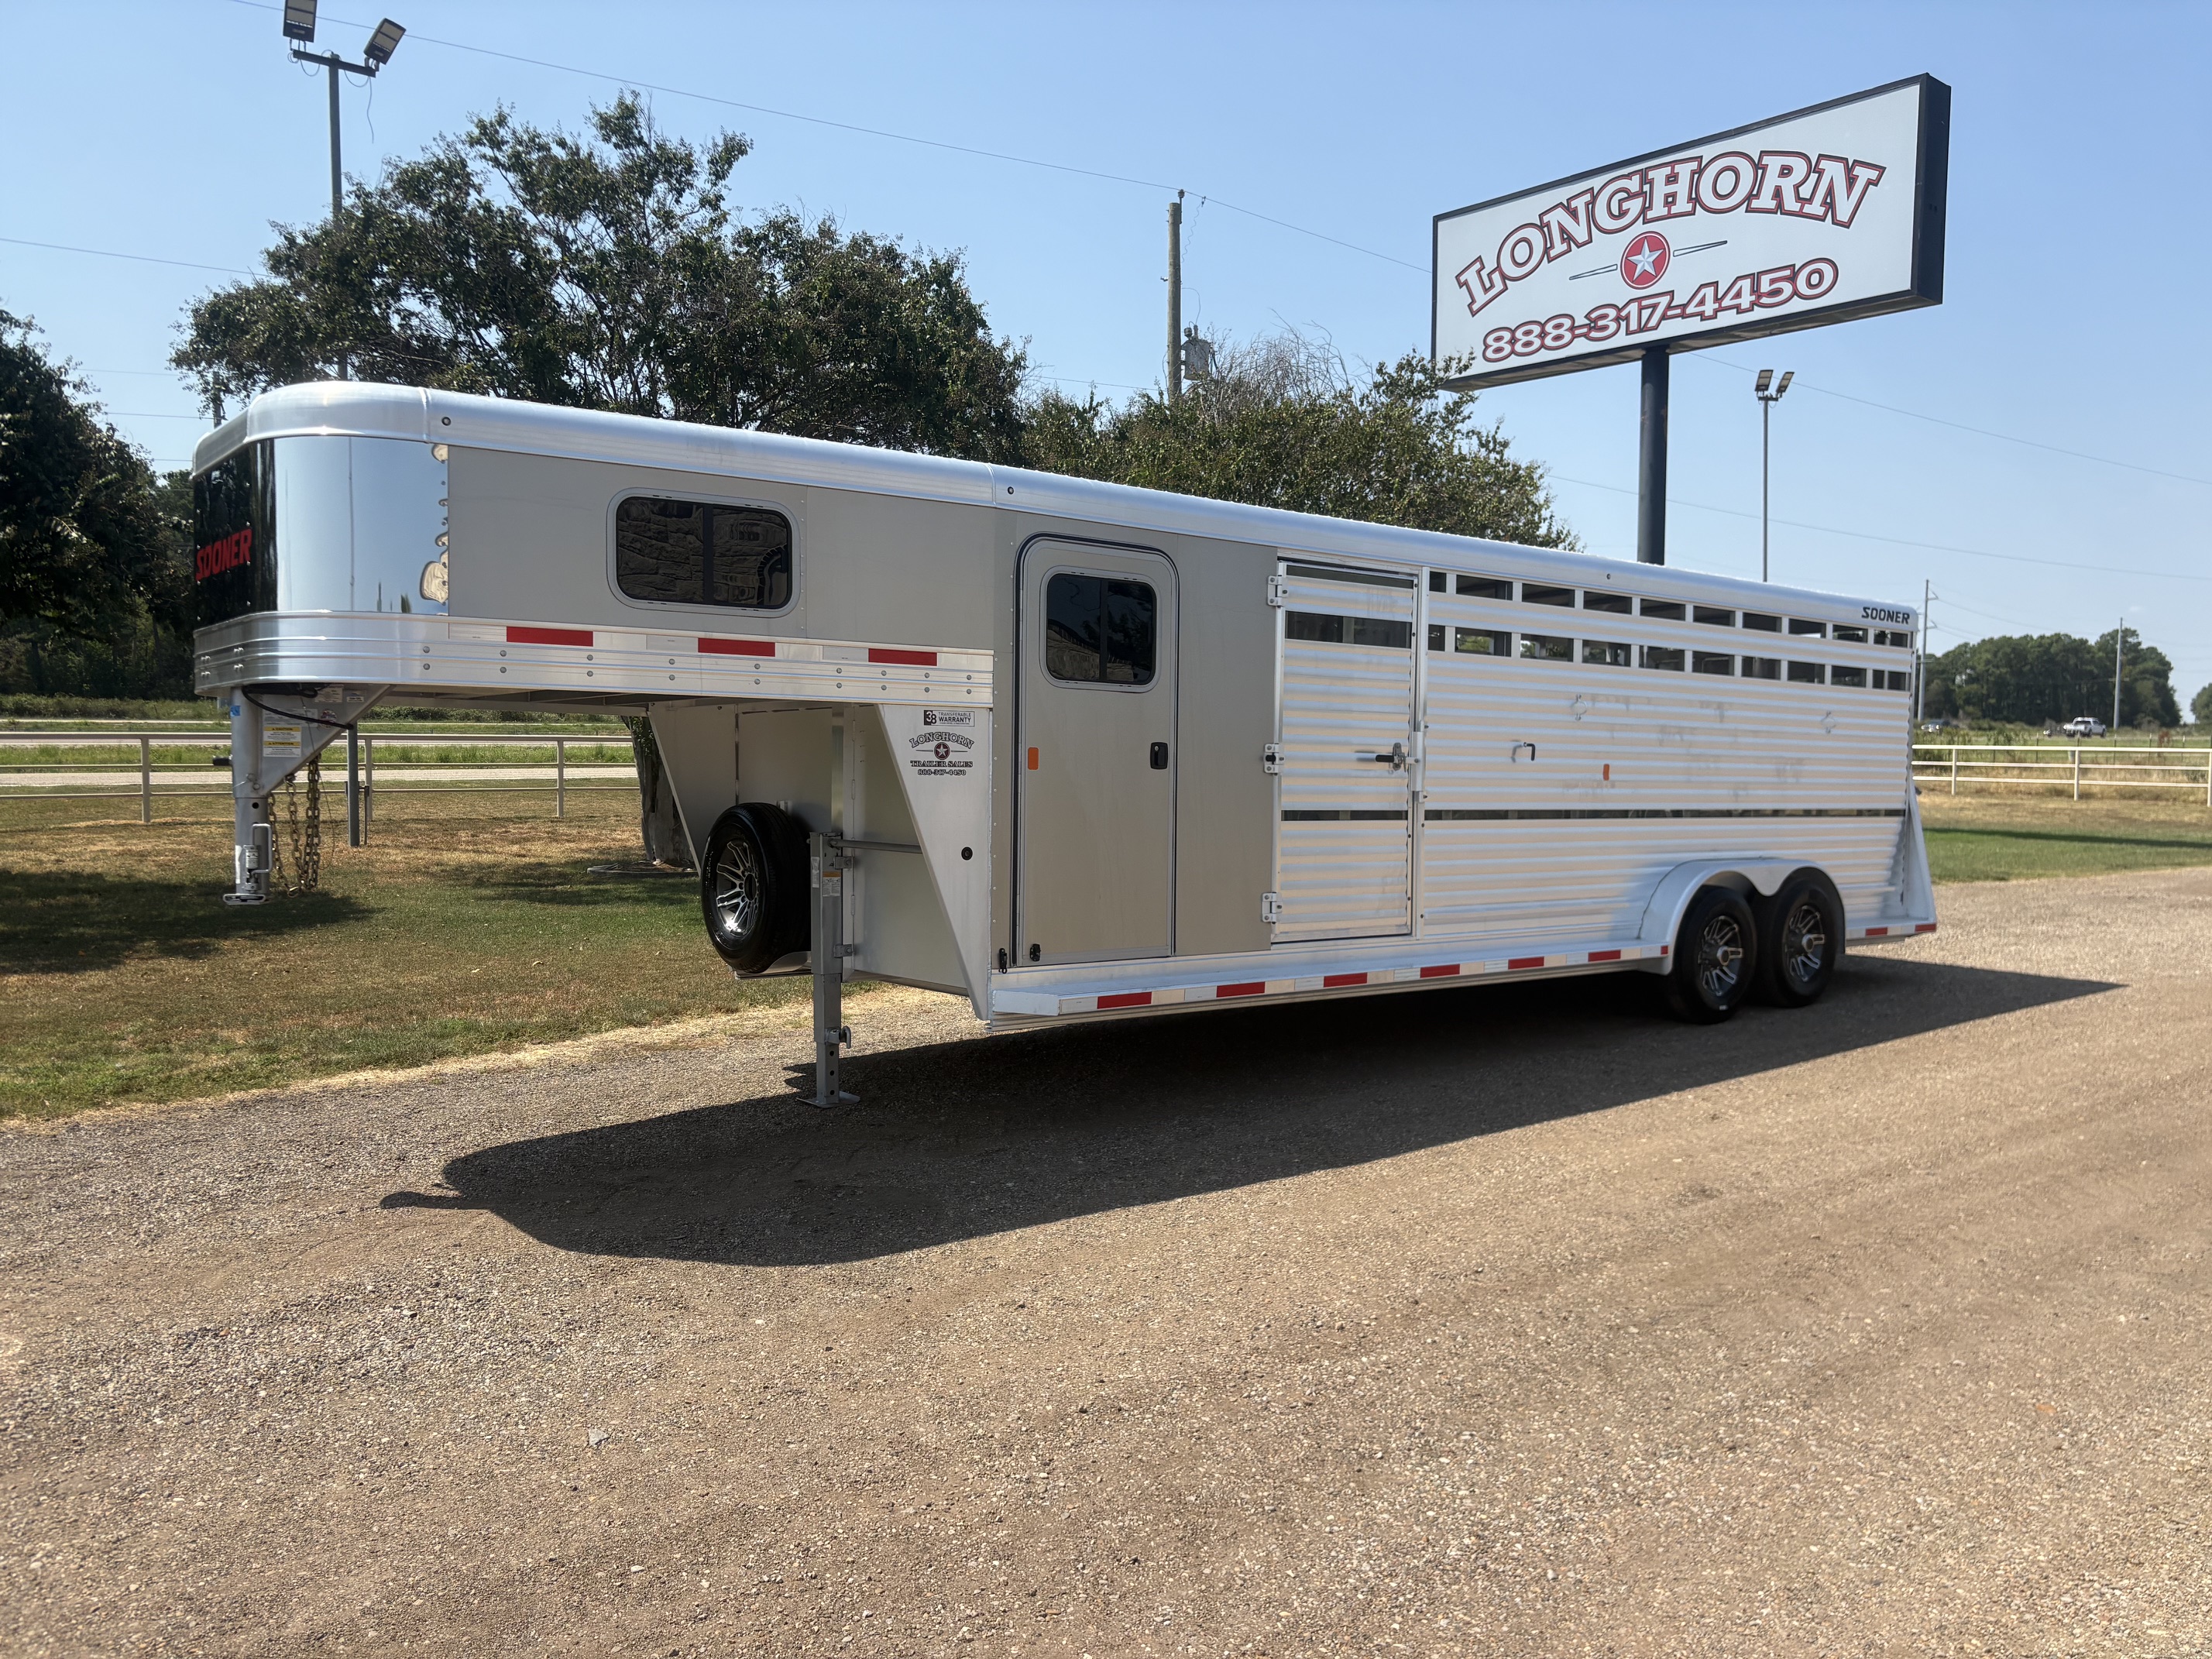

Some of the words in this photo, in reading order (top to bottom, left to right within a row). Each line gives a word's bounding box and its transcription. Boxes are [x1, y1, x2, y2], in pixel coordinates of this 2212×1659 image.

[1456, 150, 1887, 317] LONGHORN
[1482, 257, 1839, 362] 888-317-4450
[195, 528, 252, 581] SOONER
[1861, 606, 1910, 624] SOONER
[909, 732, 975, 749] LONGHORN
